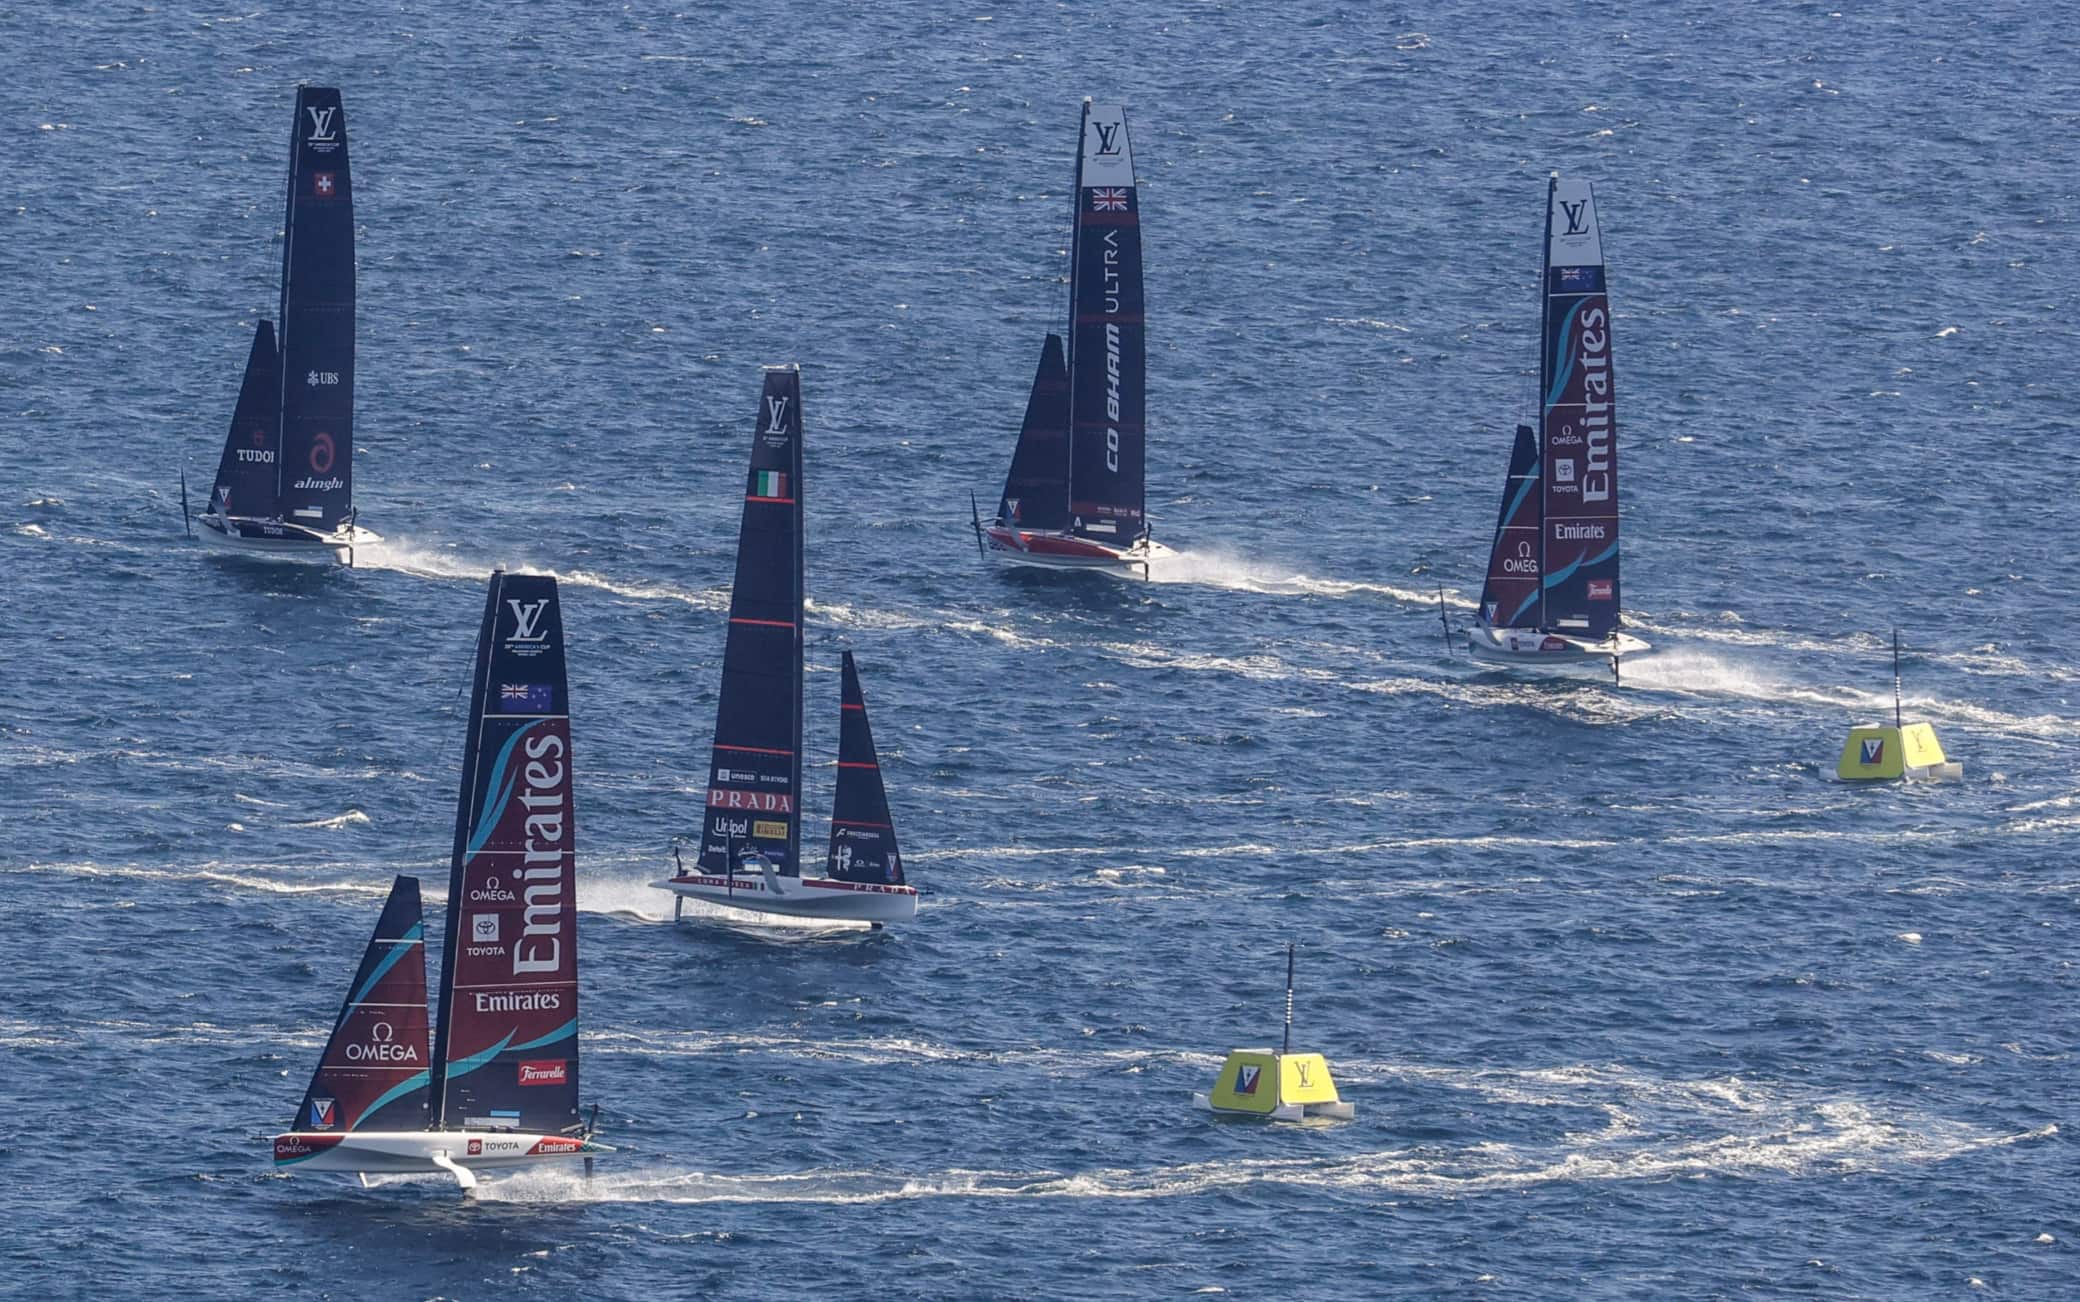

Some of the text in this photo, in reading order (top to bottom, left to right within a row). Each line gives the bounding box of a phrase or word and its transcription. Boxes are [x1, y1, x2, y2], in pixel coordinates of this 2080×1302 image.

[1103, 229, 1120, 313] ULTRA
[319, 372, 339, 385] UBS
[1580, 307, 1609, 504] Emirates
[1551, 435, 1583, 446] OMEGA
[1552, 485, 1579, 494] TOYOTA
[1554, 523, 1605, 540] Emirates
[711, 789, 790, 813] PRADA
[512, 734, 564, 976] Emirates
[470, 889, 516, 901] OMEGA
[466, 947, 505, 957] TOYOTA
[475, 992, 560, 1012] Emirates
[345, 1043, 418, 1061] OMEGA
[520, 1065, 566, 1082] Ferrarelle
[276, 1144, 312, 1153] OMEGA
[485, 1141, 520, 1151] TOYOTA
[538, 1141, 576, 1153] Emirates
